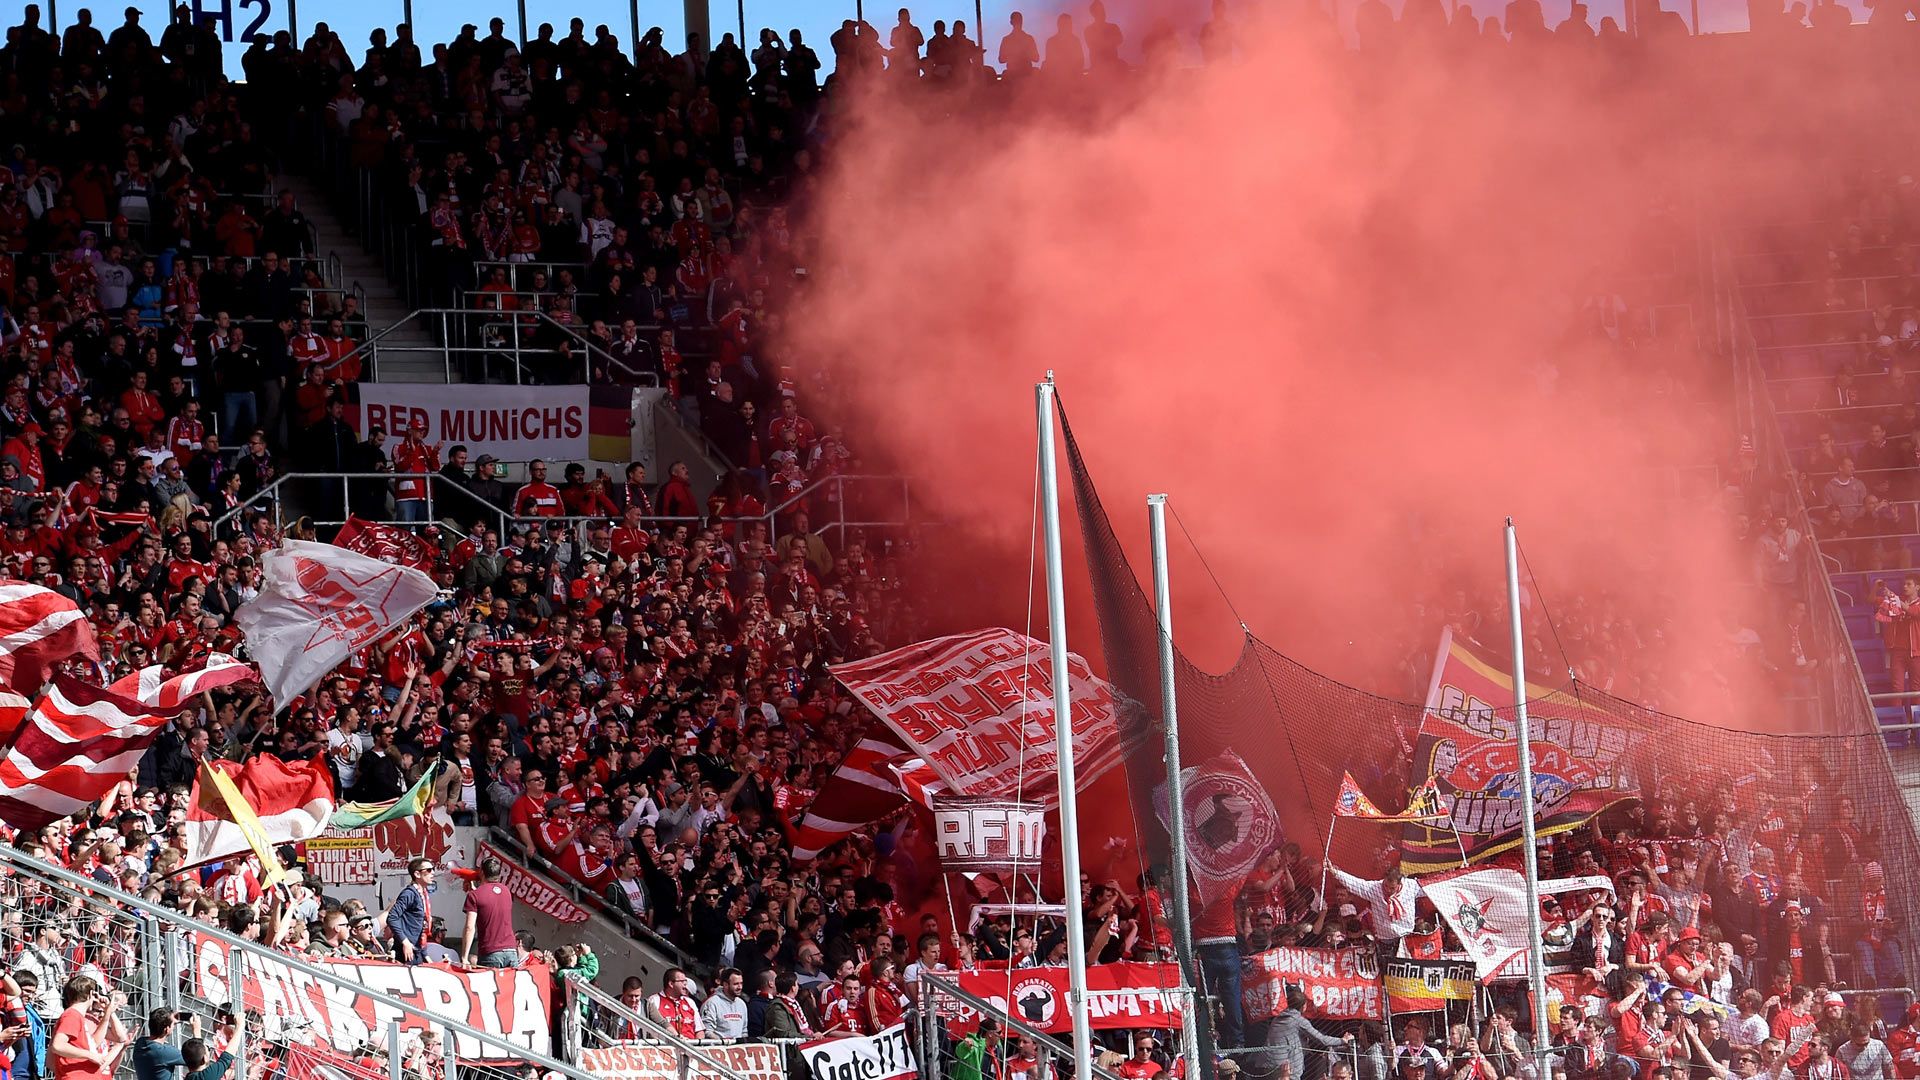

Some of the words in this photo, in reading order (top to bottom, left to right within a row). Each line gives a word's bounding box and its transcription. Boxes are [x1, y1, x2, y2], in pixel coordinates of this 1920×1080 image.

[191, 0, 274, 43] H2
[367, 403, 429, 438] RED
[440, 405, 583, 442] MUNiCHS
[934, 809, 1044, 859] RFM
[308, 849, 346, 863] STARK
[349, 849, 373, 862] SEIN
[313, 861, 374, 883] JUNGS!
[957, 994, 1008, 1024] RD
[1311, 985, 1379, 1018] PRIDE
[582, 1045, 782, 1073] AUSGESERRTE
